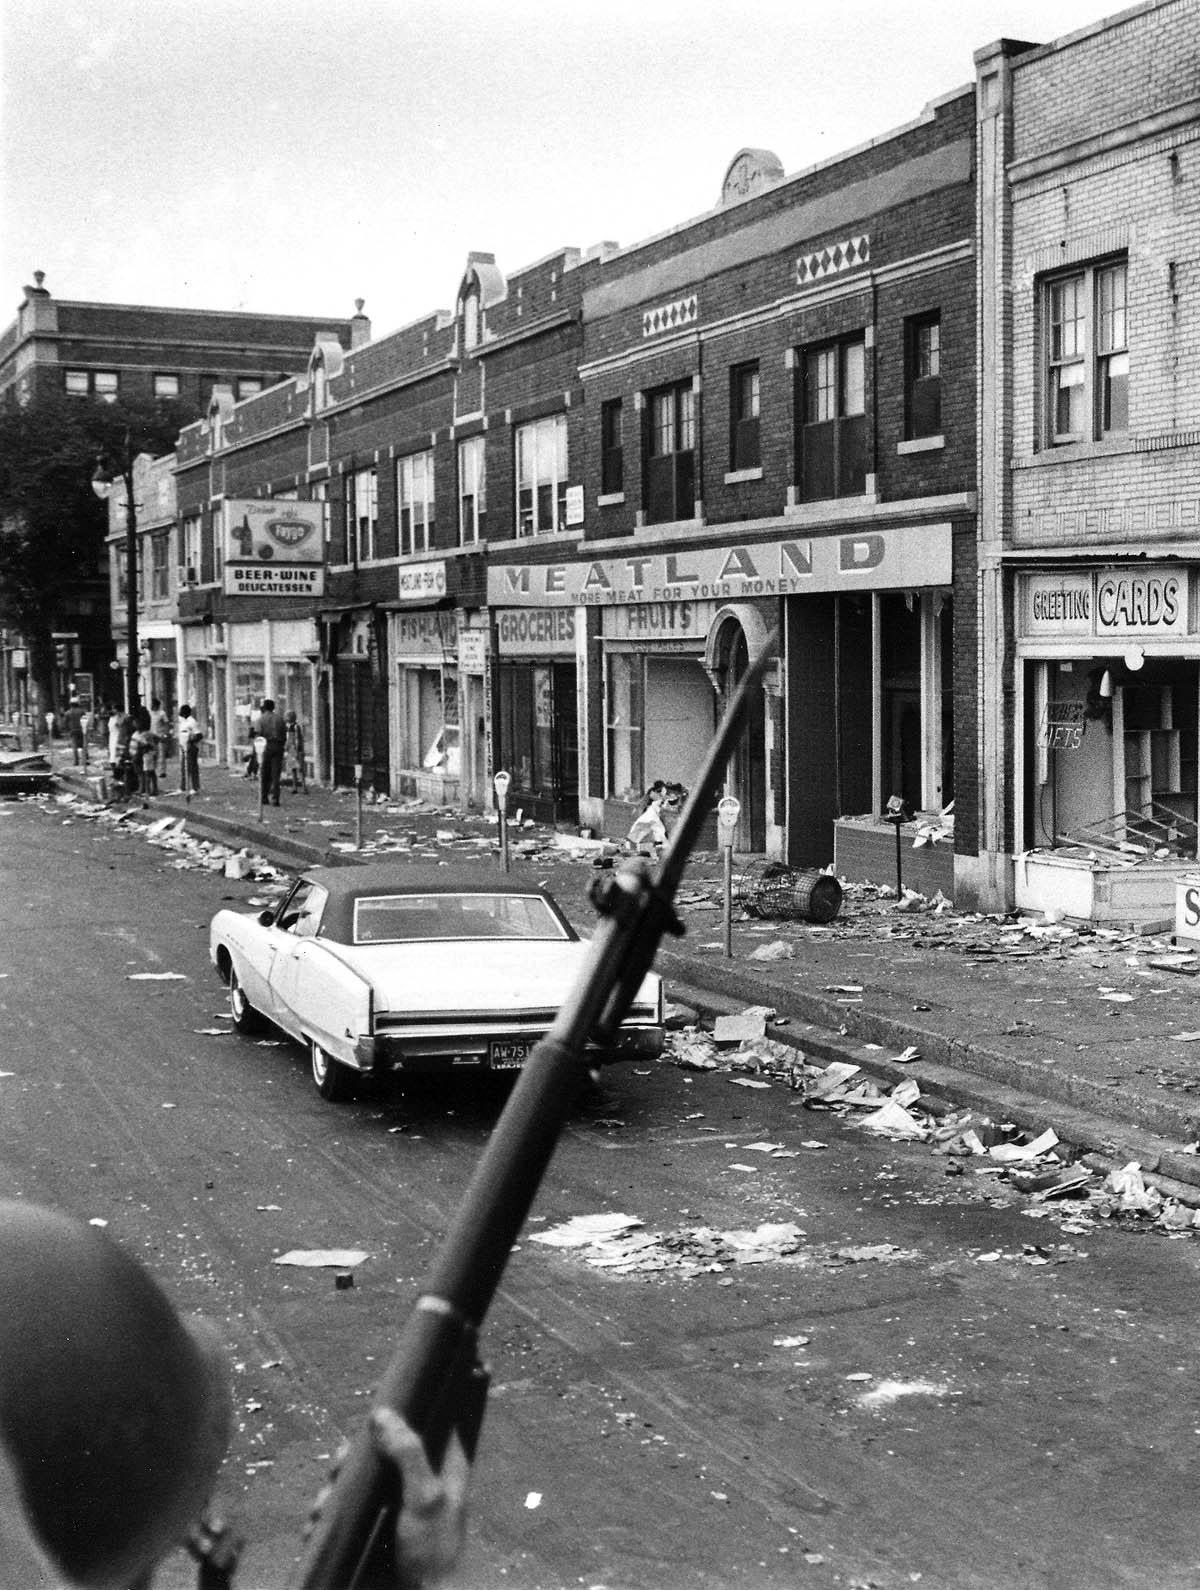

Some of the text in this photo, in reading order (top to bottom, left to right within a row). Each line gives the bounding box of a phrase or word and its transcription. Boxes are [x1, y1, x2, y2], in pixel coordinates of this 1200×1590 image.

[234, 569, 317, 581] BEER WINE
[503, 533, 887, 595] MEATLAND
[238, 582, 312, 592] DELICATESSEN
[571, 578, 800, 605] MORE MEAT FOR YOUR MONEY
[628, 601, 692, 630] FRUITS
[1033, 589, 1090, 621] GREETING
[1099, 577, 1180, 627] CARDS
[500, 610, 576, 642] GROCERIES
[1050, 726, 1083, 749] IFTS
